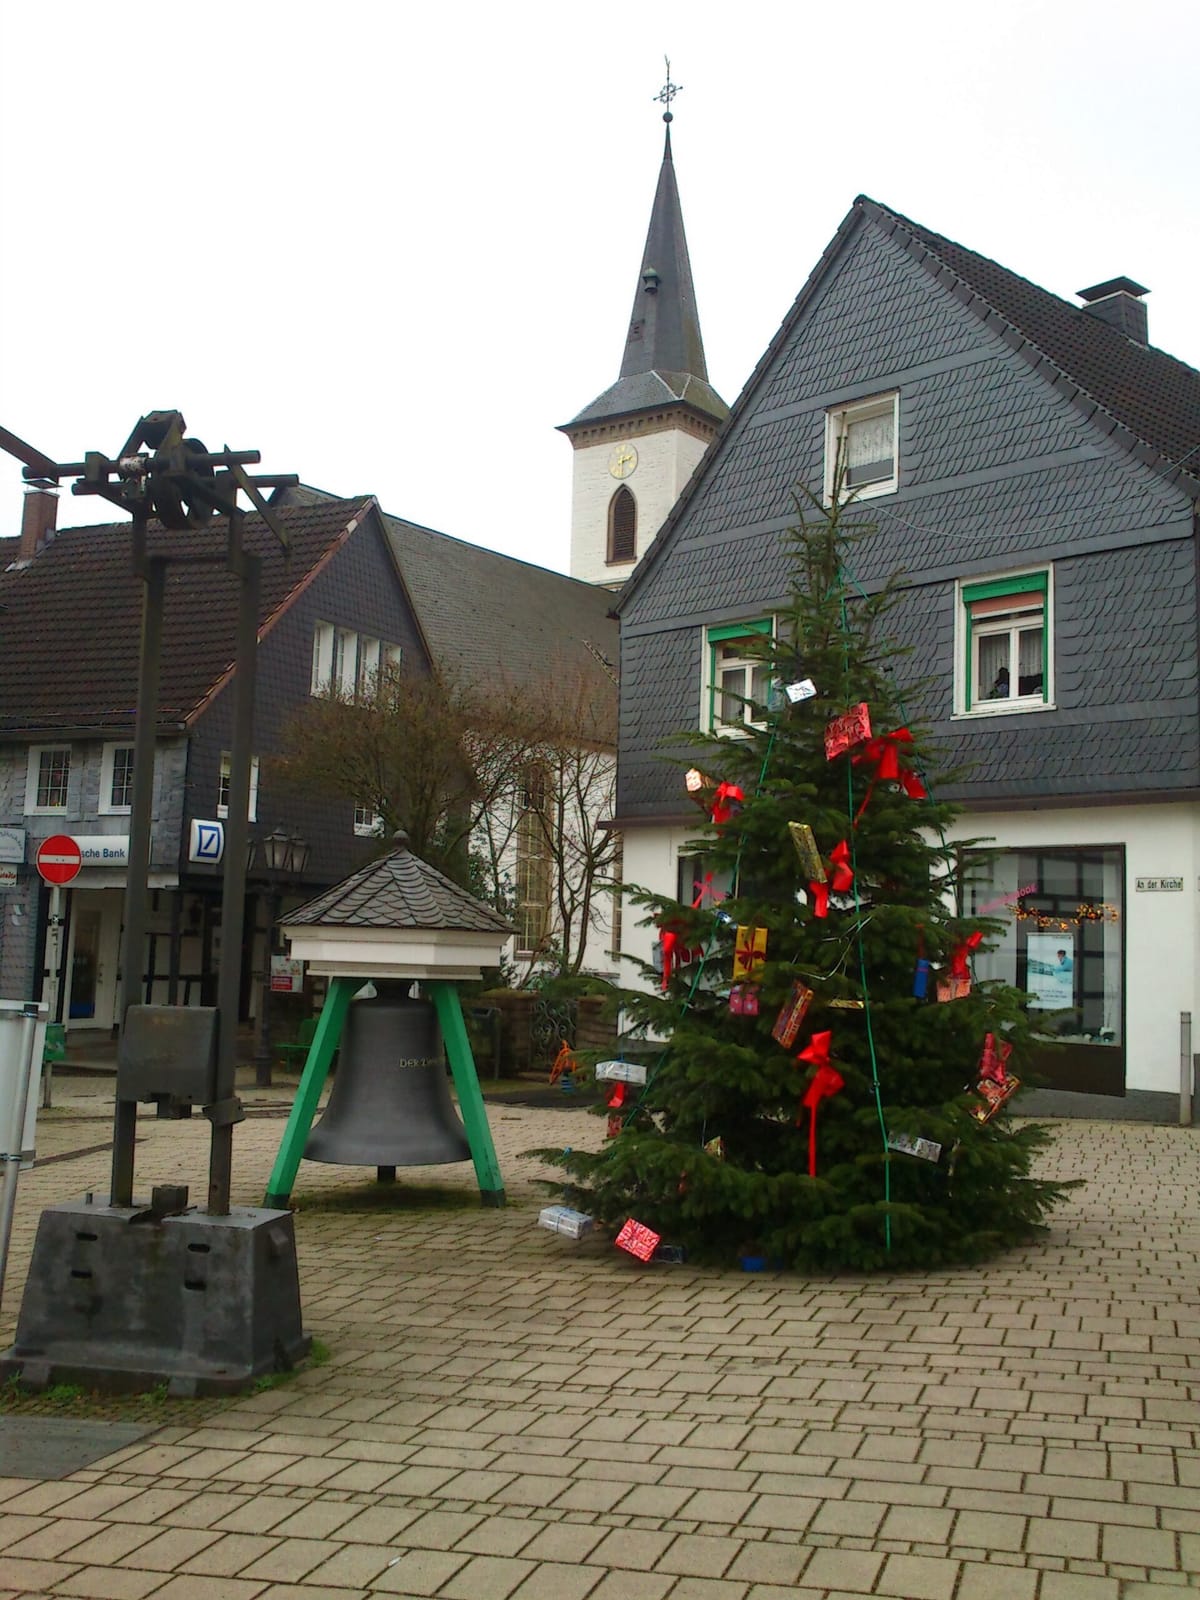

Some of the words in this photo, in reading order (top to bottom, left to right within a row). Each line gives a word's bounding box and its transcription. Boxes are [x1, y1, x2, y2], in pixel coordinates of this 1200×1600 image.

[80, 848, 100, 858] sche
[103, 848, 125, 858] Bank
[1160, 879, 1182, 889] Kirche
